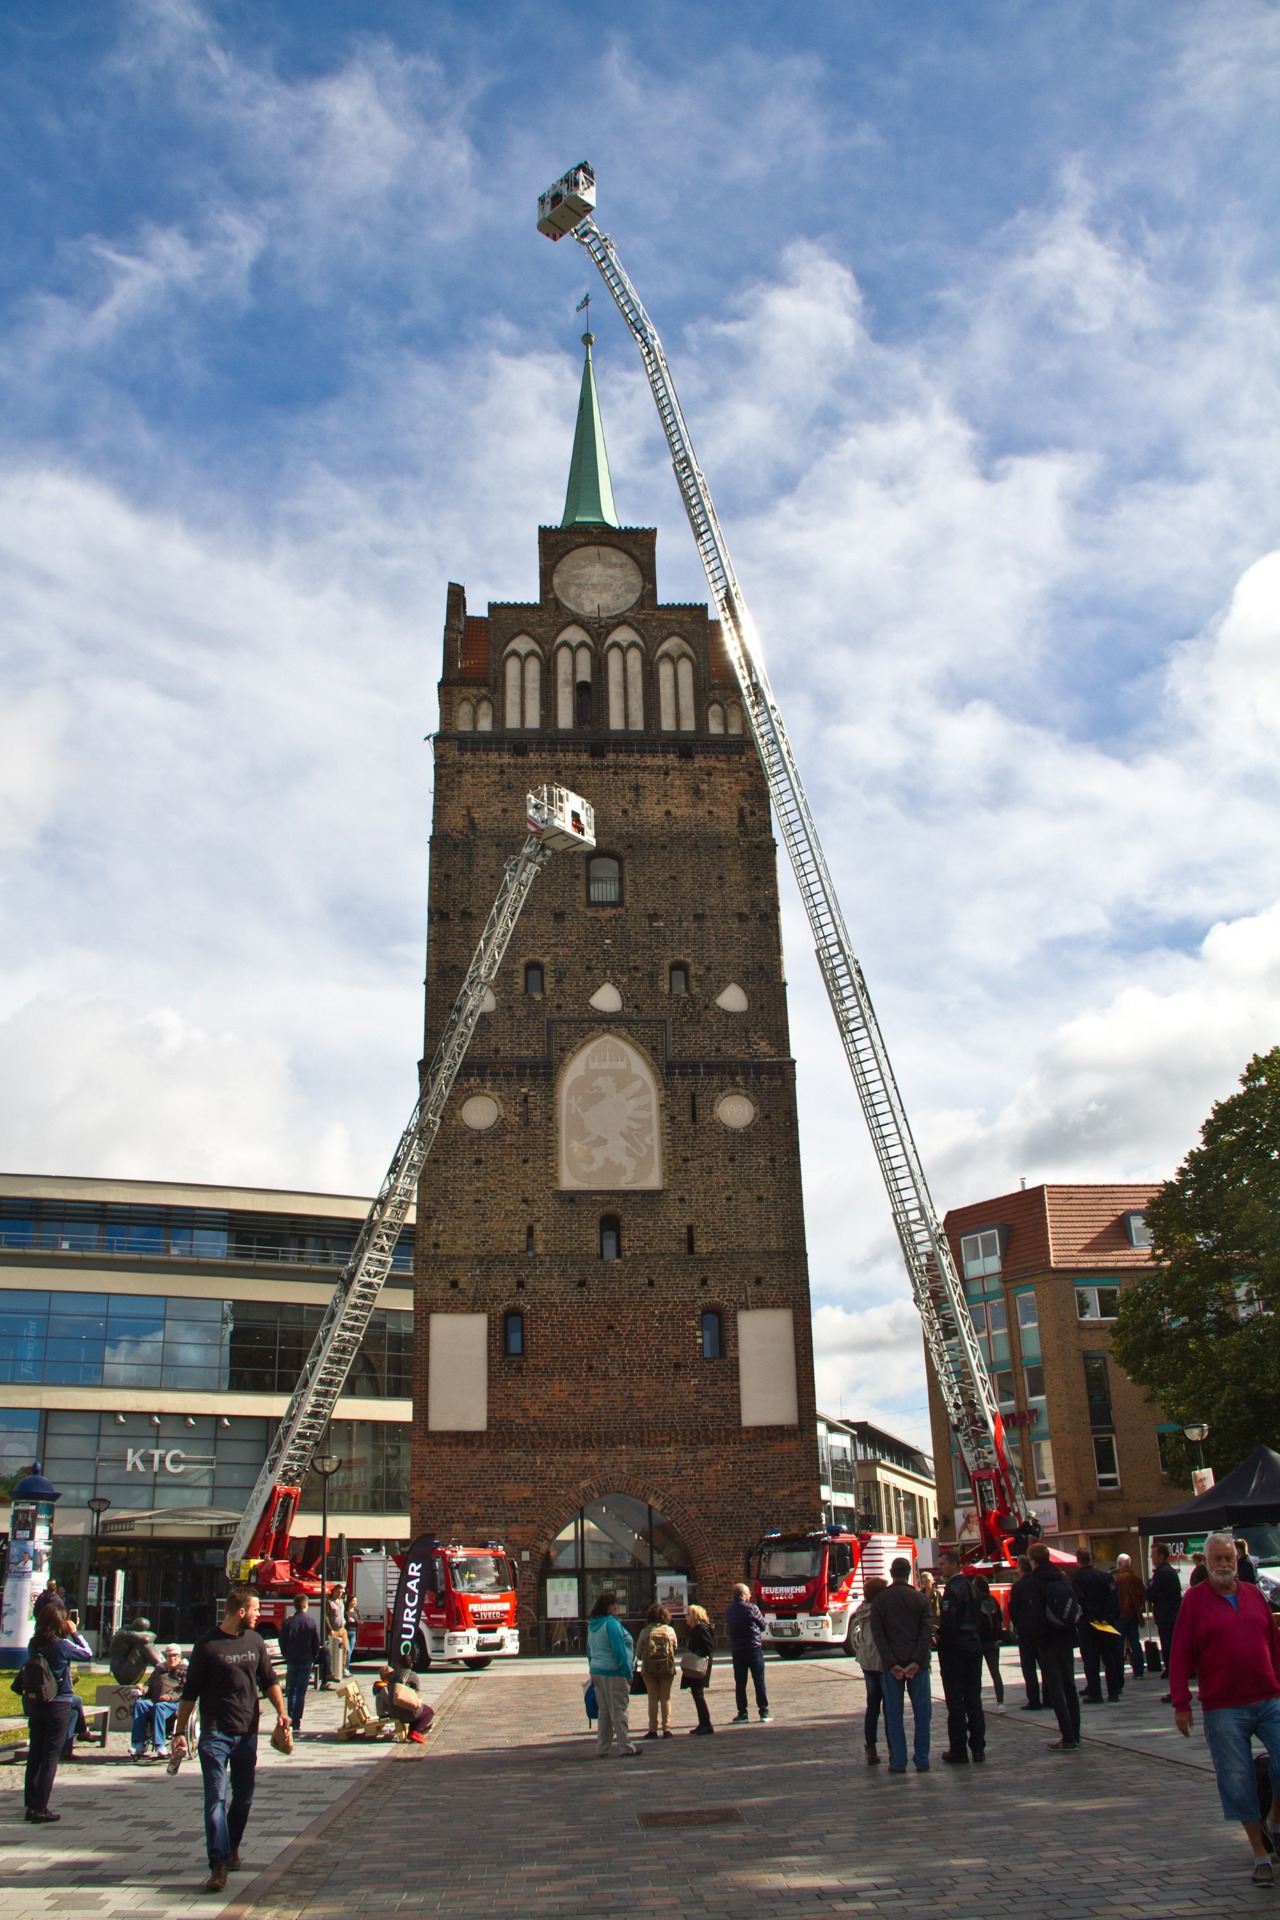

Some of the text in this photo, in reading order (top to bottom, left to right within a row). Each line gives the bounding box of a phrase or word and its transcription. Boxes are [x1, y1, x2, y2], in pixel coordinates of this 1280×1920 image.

[126, 1448, 186, 1473] KTC
[761, 1585, 806, 1595] FEUERWEHR
[468, 1602, 510, 1612] FEUERWEHR
[219, 1650, 256, 1664] ench
